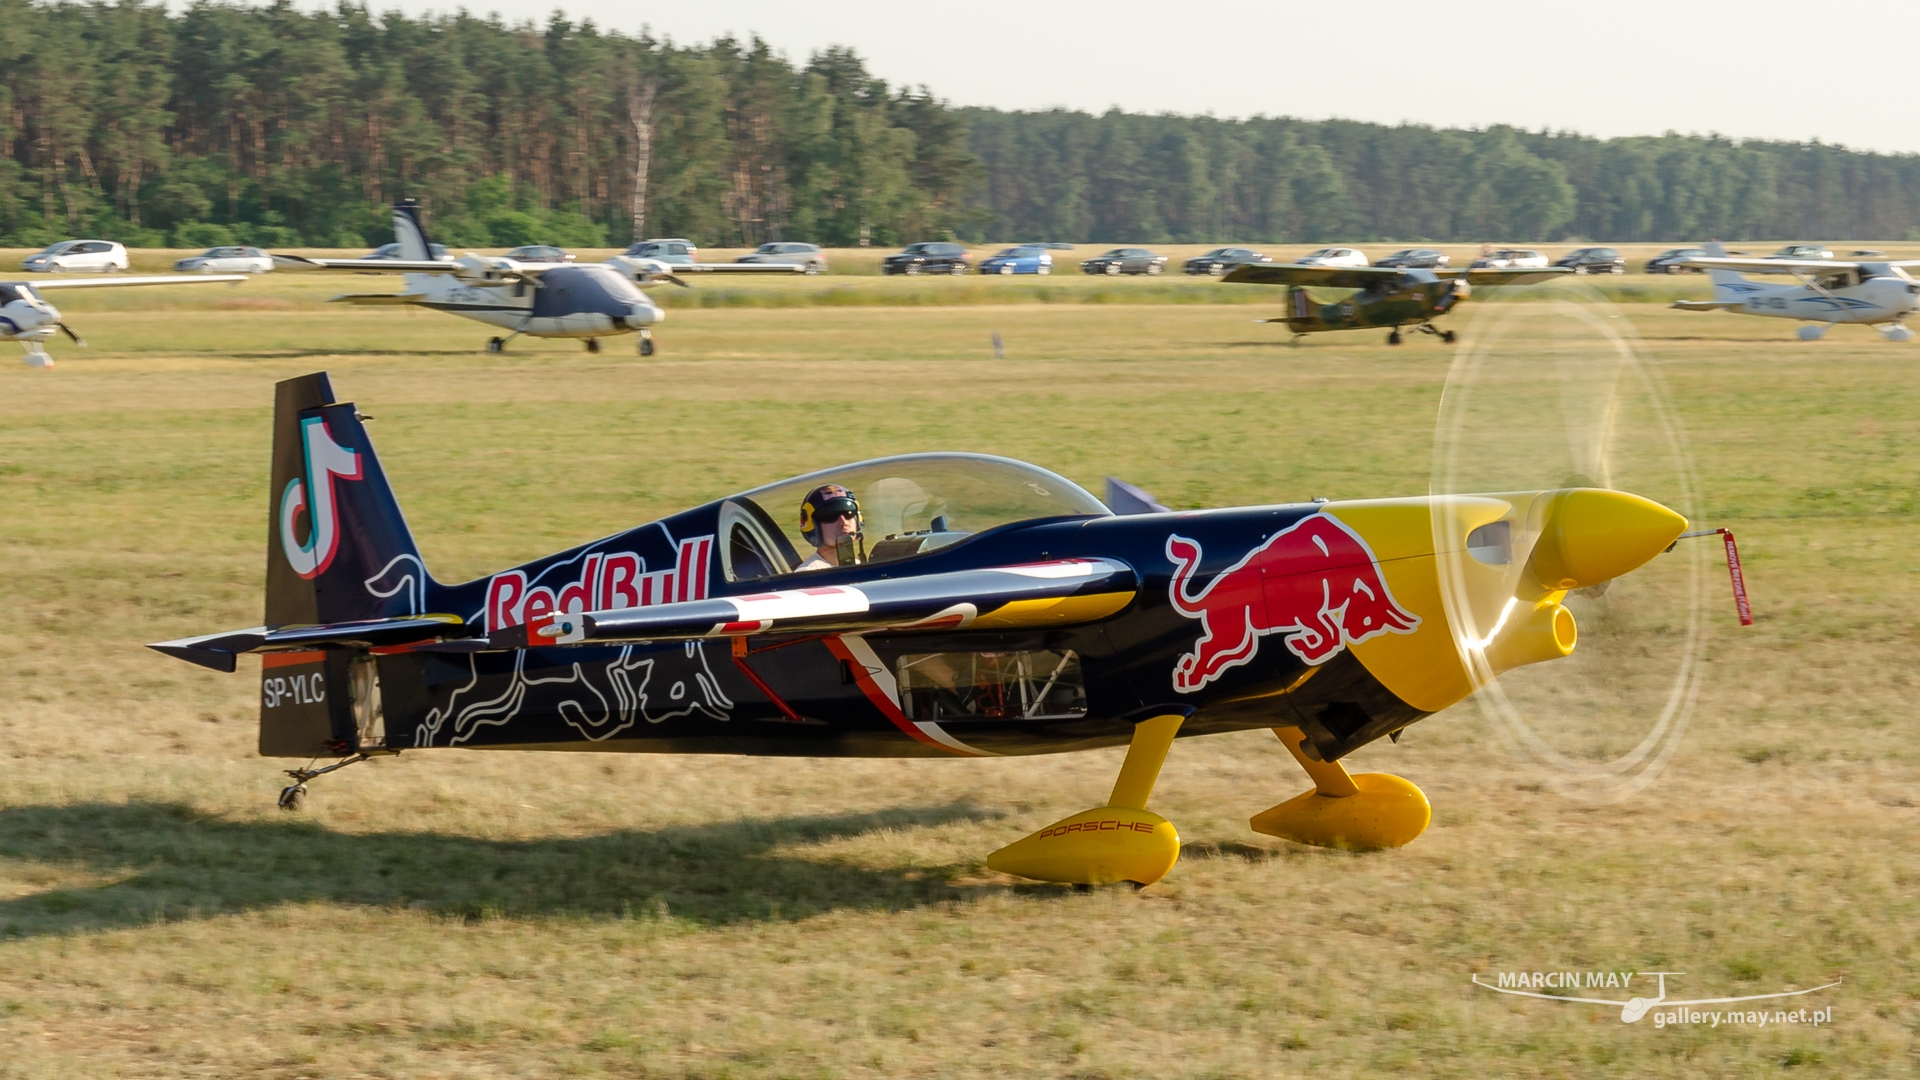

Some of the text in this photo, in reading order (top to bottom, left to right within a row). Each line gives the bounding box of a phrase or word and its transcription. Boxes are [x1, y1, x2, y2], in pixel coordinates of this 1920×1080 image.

[1727, 541, 1738, 568] REMOVE
[1732, 569, 1744, 595] BEFORE
[263, 672, 326, 708] SP-YLC
[1039, 820, 1155, 841] PORSCHE
